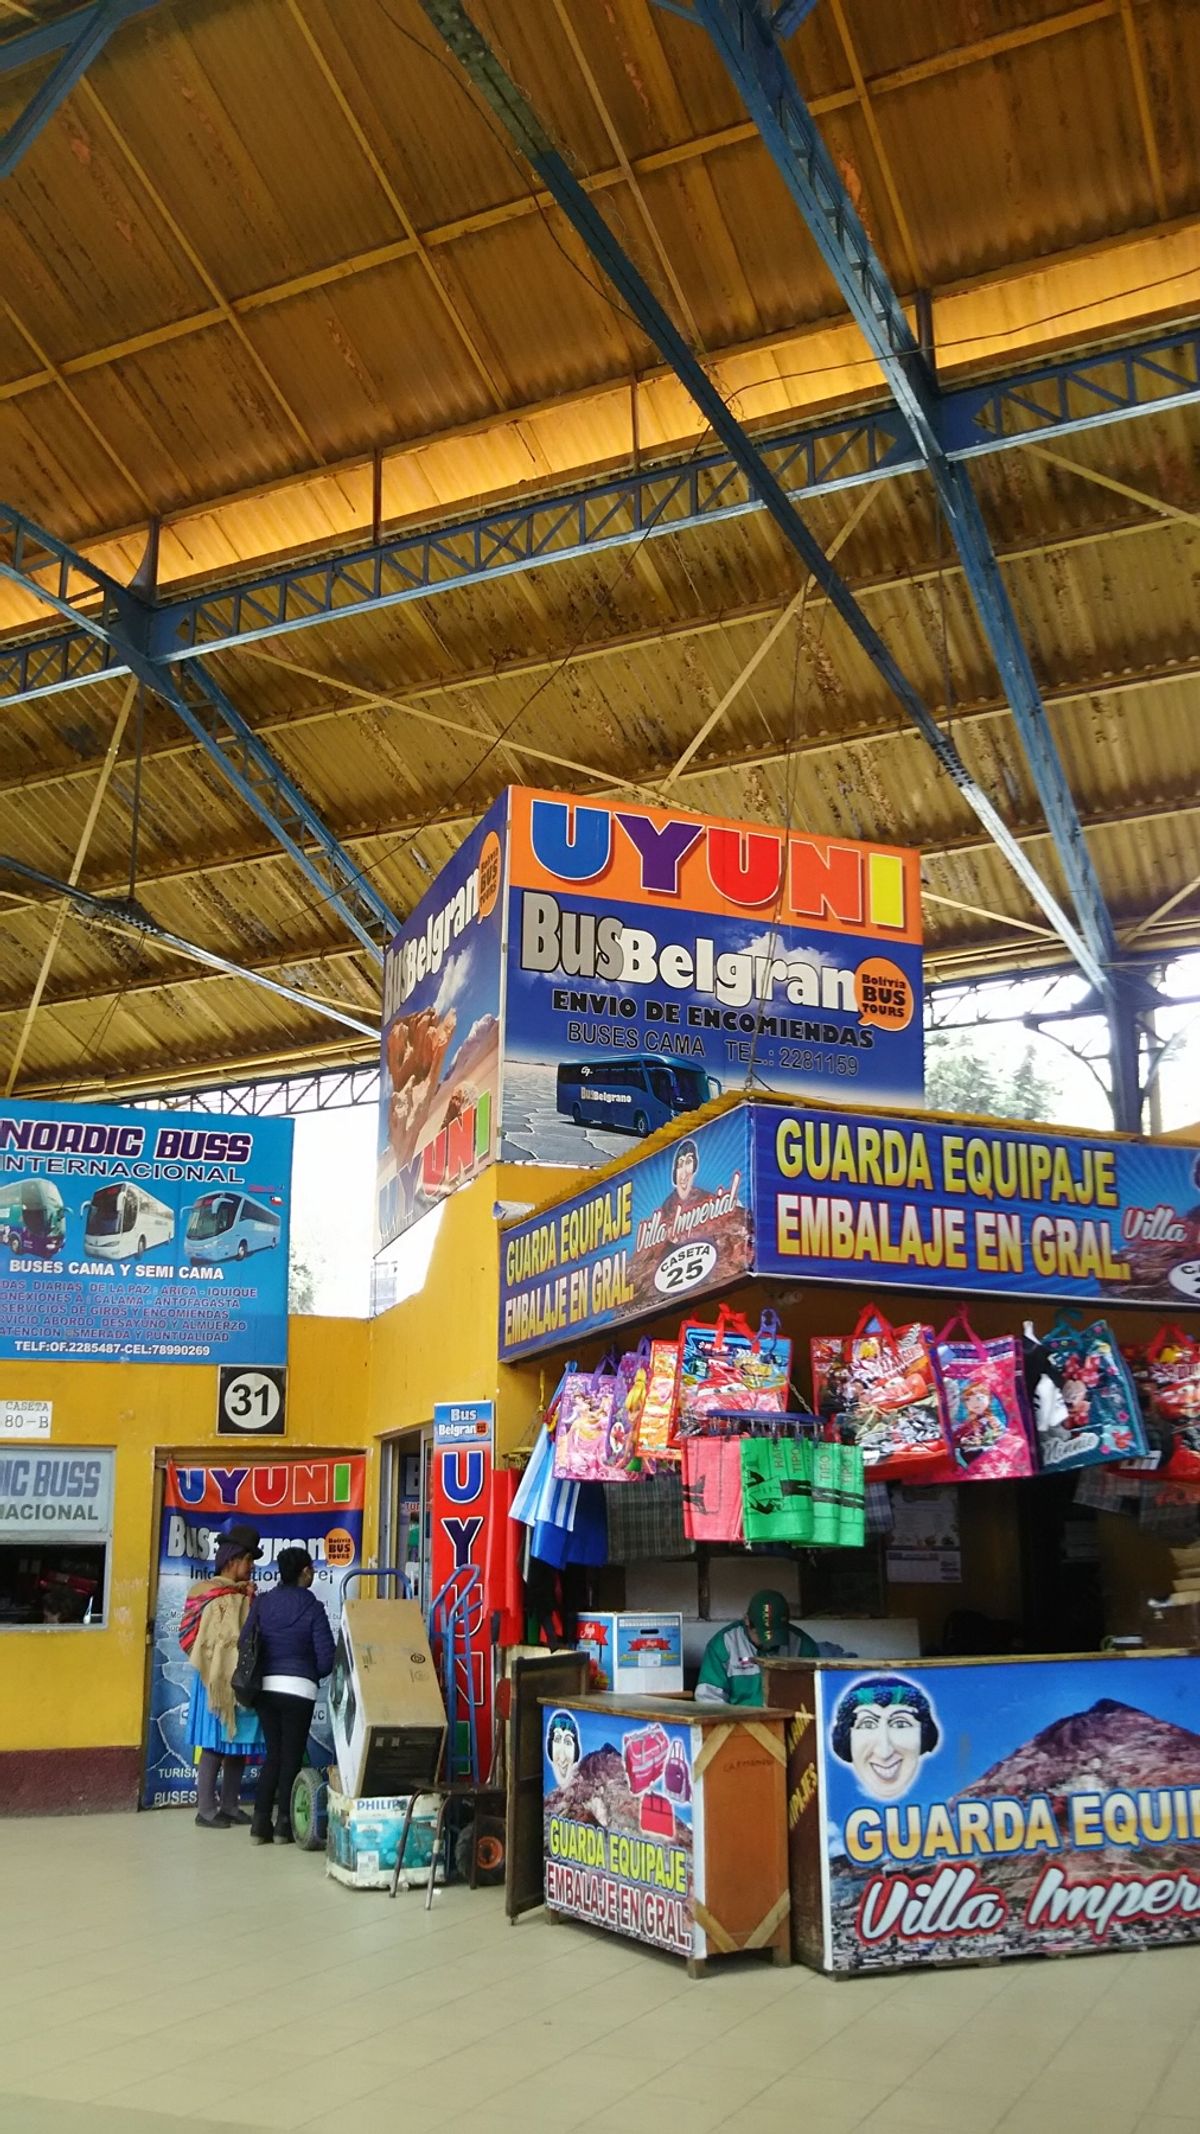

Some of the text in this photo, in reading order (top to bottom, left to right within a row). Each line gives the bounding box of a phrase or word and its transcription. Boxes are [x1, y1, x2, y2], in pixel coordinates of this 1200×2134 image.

[532, 799, 906, 928] UYUNI
[861, 973, 906, 989] Bolivia
[862, 985, 906, 1007] BUS
[552, 989, 874, 1049] ENVIO DE ENCOMIENDAS
[862, 1003, 905, 1018] TOURS
[568, 1022, 638, 1049] BUSES
[645, 1030, 706, 1057] CAMA
[778, 1047, 859, 1077] 2281159
[0, 1118, 253, 1165] NORDIC BUSS
[774, 1116, 1119, 1207] GUARDA EQUIPAJE
[635, 1170, 742, 1253] Villa Imperial
[1123, 1206, 1188, 1242] Villa
[506, 1182, 633, 1287] GUARDA EQUIPAJE
[775, 1192, 968, 1270] EMBALAJE
[974, 1209, 1024, 1275] EN
[1031, 1214, 1132, 1282] GRAL.
[9, 1260, 225, 1280] BUSES CAMA Y SEMI CAMA
[660, 1244, 711, 1274] CASETA
[665, 1258, 703, 1290] 25
[33, 1281, 82, 1292] DIARIAS
[90, 1283, 105, 1293] DE
[109, 1284, 125, 1294] LA
[128, 1285, 151, 1295] PAZ
[161, 1286, 197, 1297] ARICA
[207, 1287, 258, 1298] IQUIQUE
[93, 1294, 144, 1306] CALAMA
[154, 1297, 241, 1308] ANTOFAGASTA
[504, 1250, 635, 1346] EMBALAJE EN GRAL.
[1, 1303, 230, 1320] SERVICIOS DE GIROS Y ENCOMIENDAS
[43, 1316, 95, 1327] ABORDO
[102, 1318, 167, 1330] DESAYUNO
[171, 1320, 179, 1329] Y
[182, 1321, 247, 1332] ALMUERZO
[134, 1331, 142, 1340] Y
[145, 1331, 230, 1342] PUNTUALIDAD
[5, 1401, 49, 1411] CASETA
[230, 1383, 270, 1417] 31
[450, 1408, 477, 1422] Bus
[32, 1461, 102, 1497] BUSS
[176, 1463, 351, 1507] UYUNI
[328, 1543, 351, 1554] BUS
[845, 1788, 1200, 1865] GUARDA EQUI
[550, 1817, 687, 1894] GUARDA EQUIPAJE
[546, 1861, 692, 1951] EMBALAJE EN GRAL.
[861, 1867, 1005, 1940] Villa
